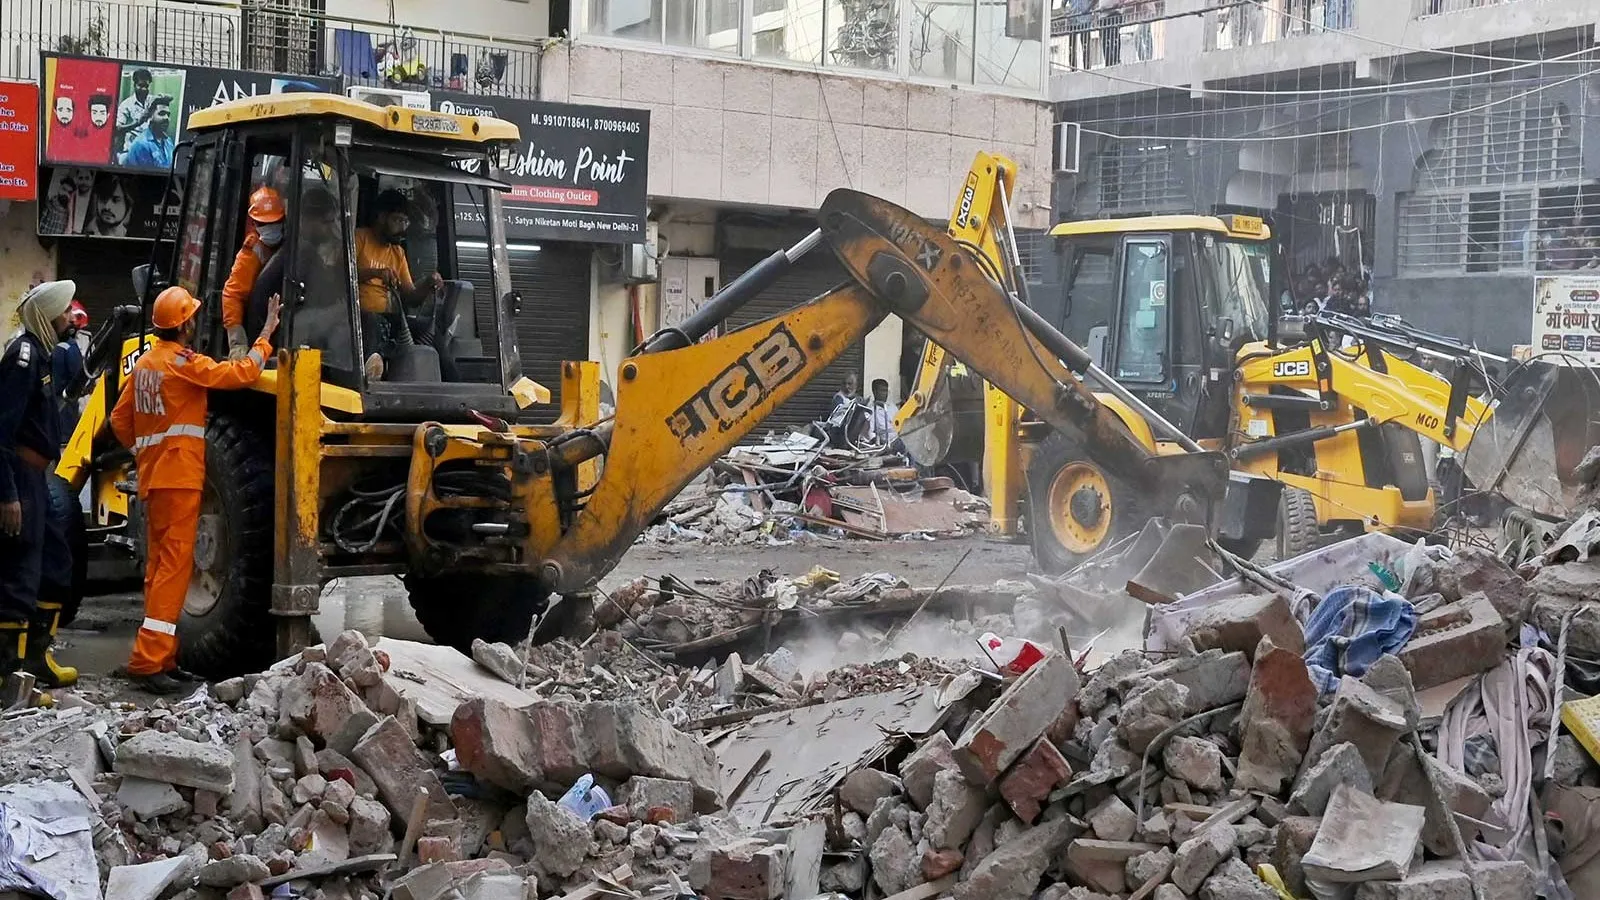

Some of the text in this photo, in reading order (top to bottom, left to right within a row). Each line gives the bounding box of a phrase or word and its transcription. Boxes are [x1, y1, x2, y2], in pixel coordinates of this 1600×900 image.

[456, 106, 473, 116] Days
[474, 107, 493, 118] Open
[10, 122, 29, 133] Fries
[531, 113, 640, 133] M. 9910718641, 8700969405
[573, 146, 635, 185] Point
[530, 187, 565, 203] Clothing
[566, 190, 592, 202] Outlet
[515, 216, 533, 227] Satya
[535, 218, 560, 228] Niketan
[562, 219, 578, 228] Moti
[580, 220, 595, 231] Bagh
[597, 221, 611, 230] New
[613, 222, 639, 232] Delhi-21
[1274, 361, 1309, 376] JCB
[668, 325, 803, 440] JCB
[1416, 413, 1439, 429] MCD
